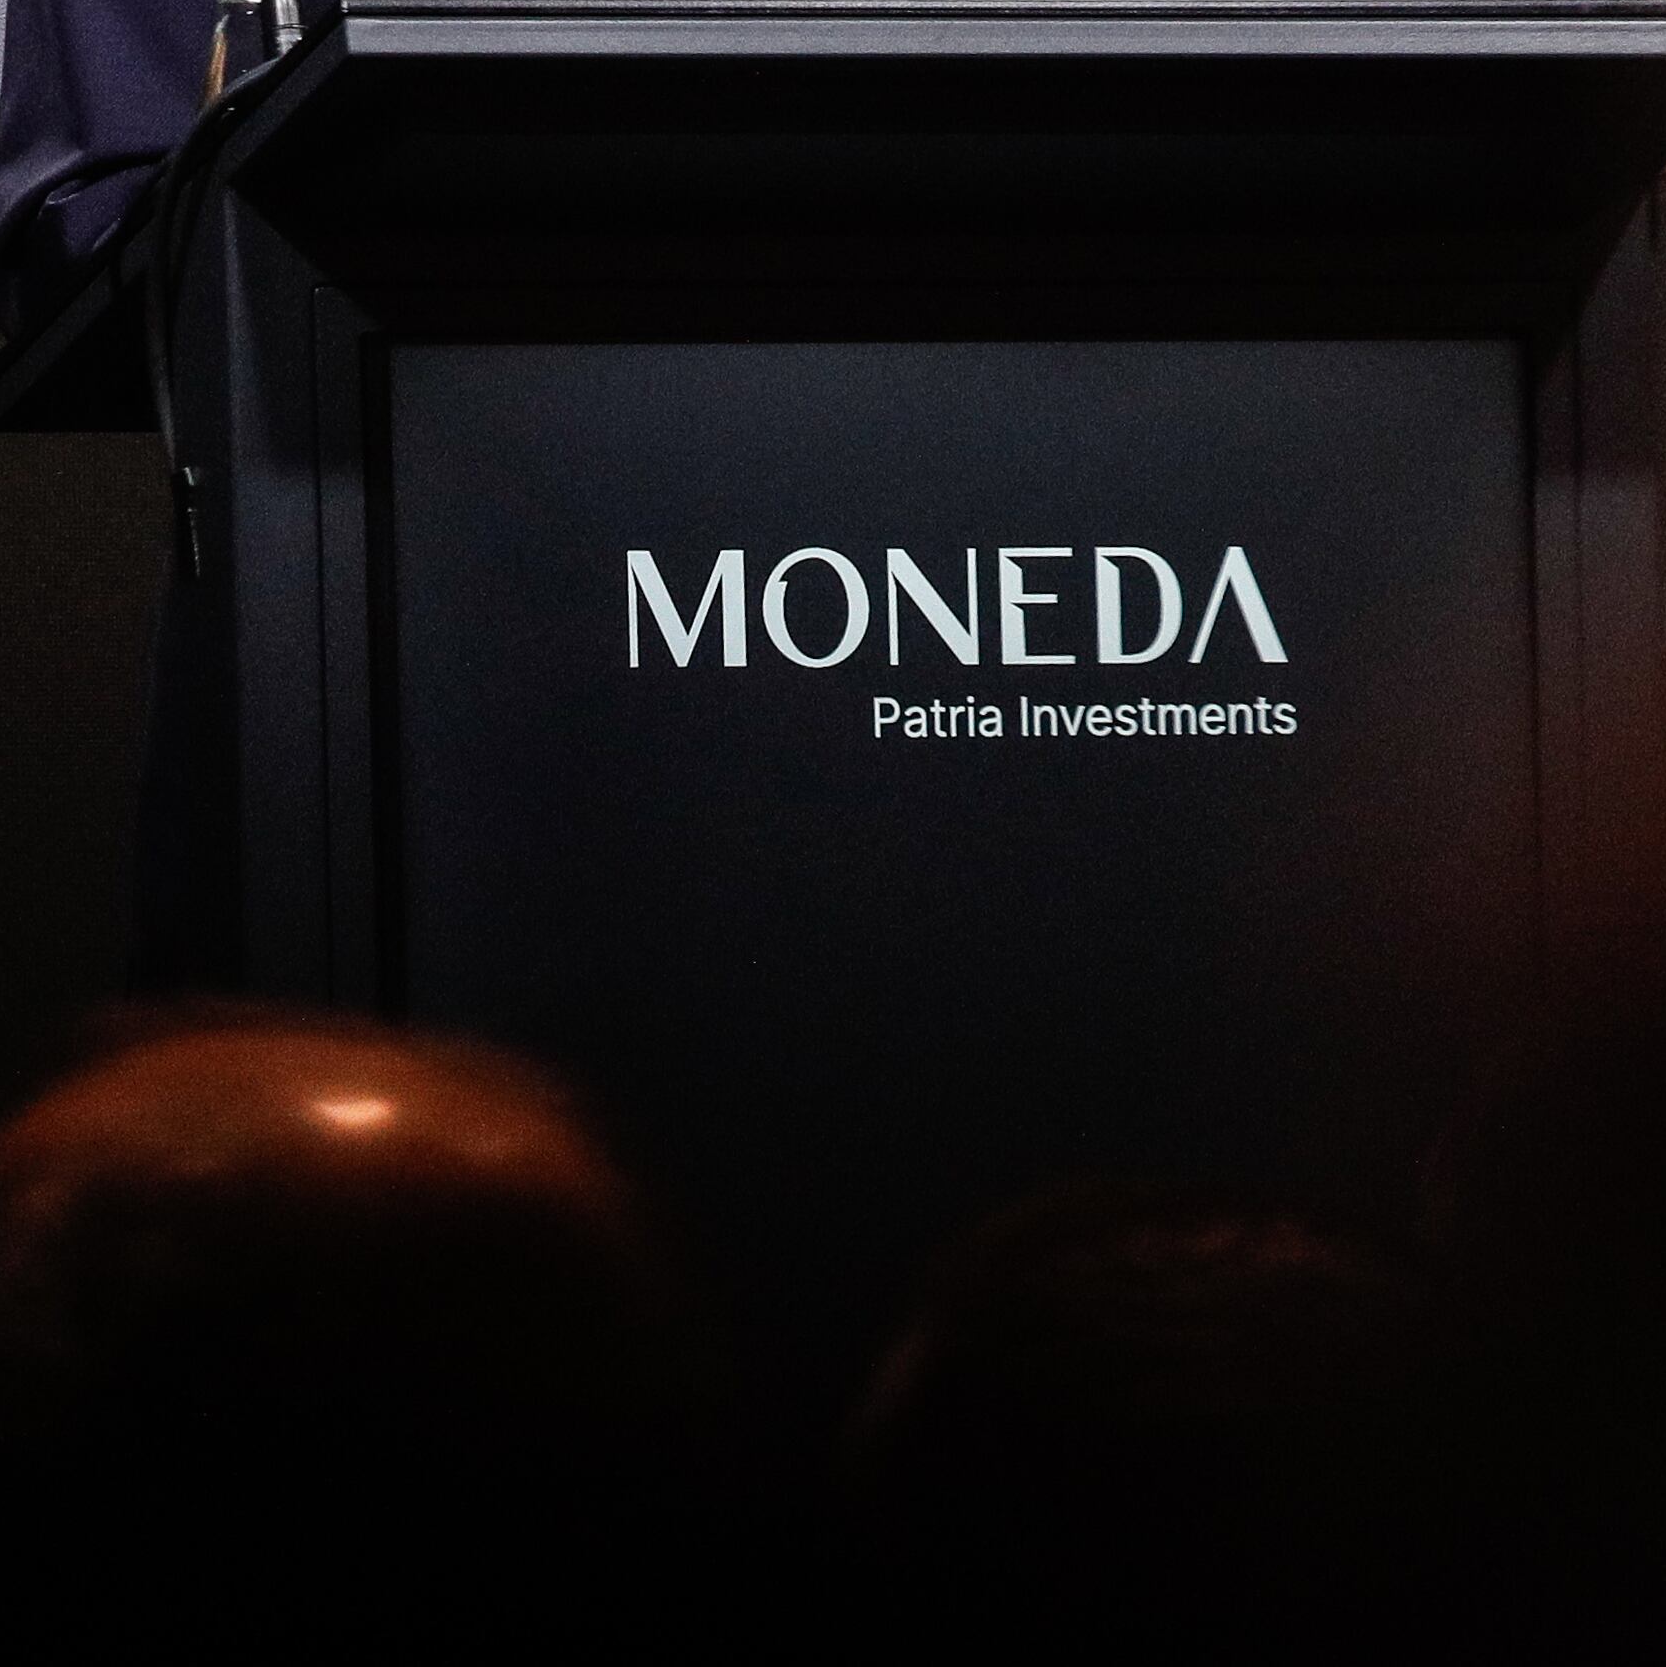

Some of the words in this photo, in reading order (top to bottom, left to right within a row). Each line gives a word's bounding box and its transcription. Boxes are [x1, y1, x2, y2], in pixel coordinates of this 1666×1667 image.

[626, 546, 1288, 668] MONEDA
[872, 696, 1004, 739] Patria
[1020, 696, 1298, 737] Investments
